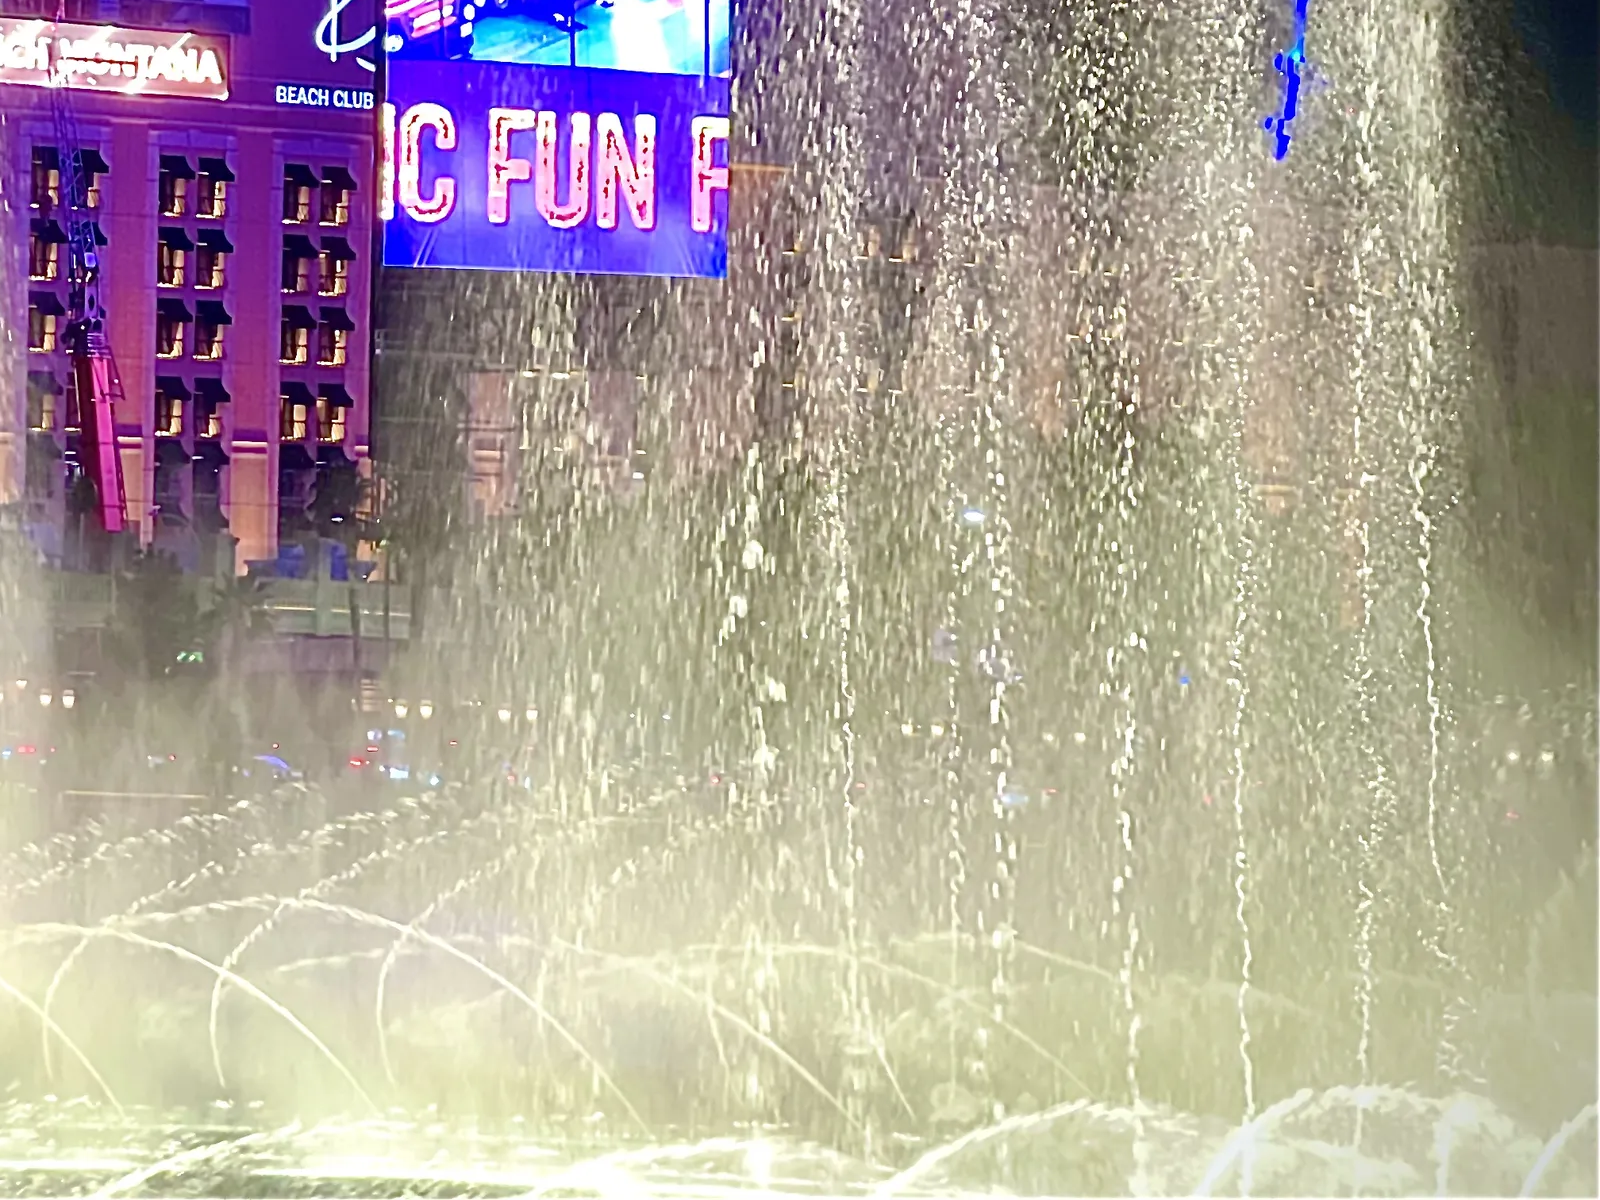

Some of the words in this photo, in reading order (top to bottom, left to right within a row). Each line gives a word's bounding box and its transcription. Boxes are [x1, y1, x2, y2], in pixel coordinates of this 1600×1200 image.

[58, 37, 224, 84] MONTANA
[275, 85, 330, 107] BEACH
[333, 89, 375, 110] CLUB
[486, 106, 657, 232] FUN
